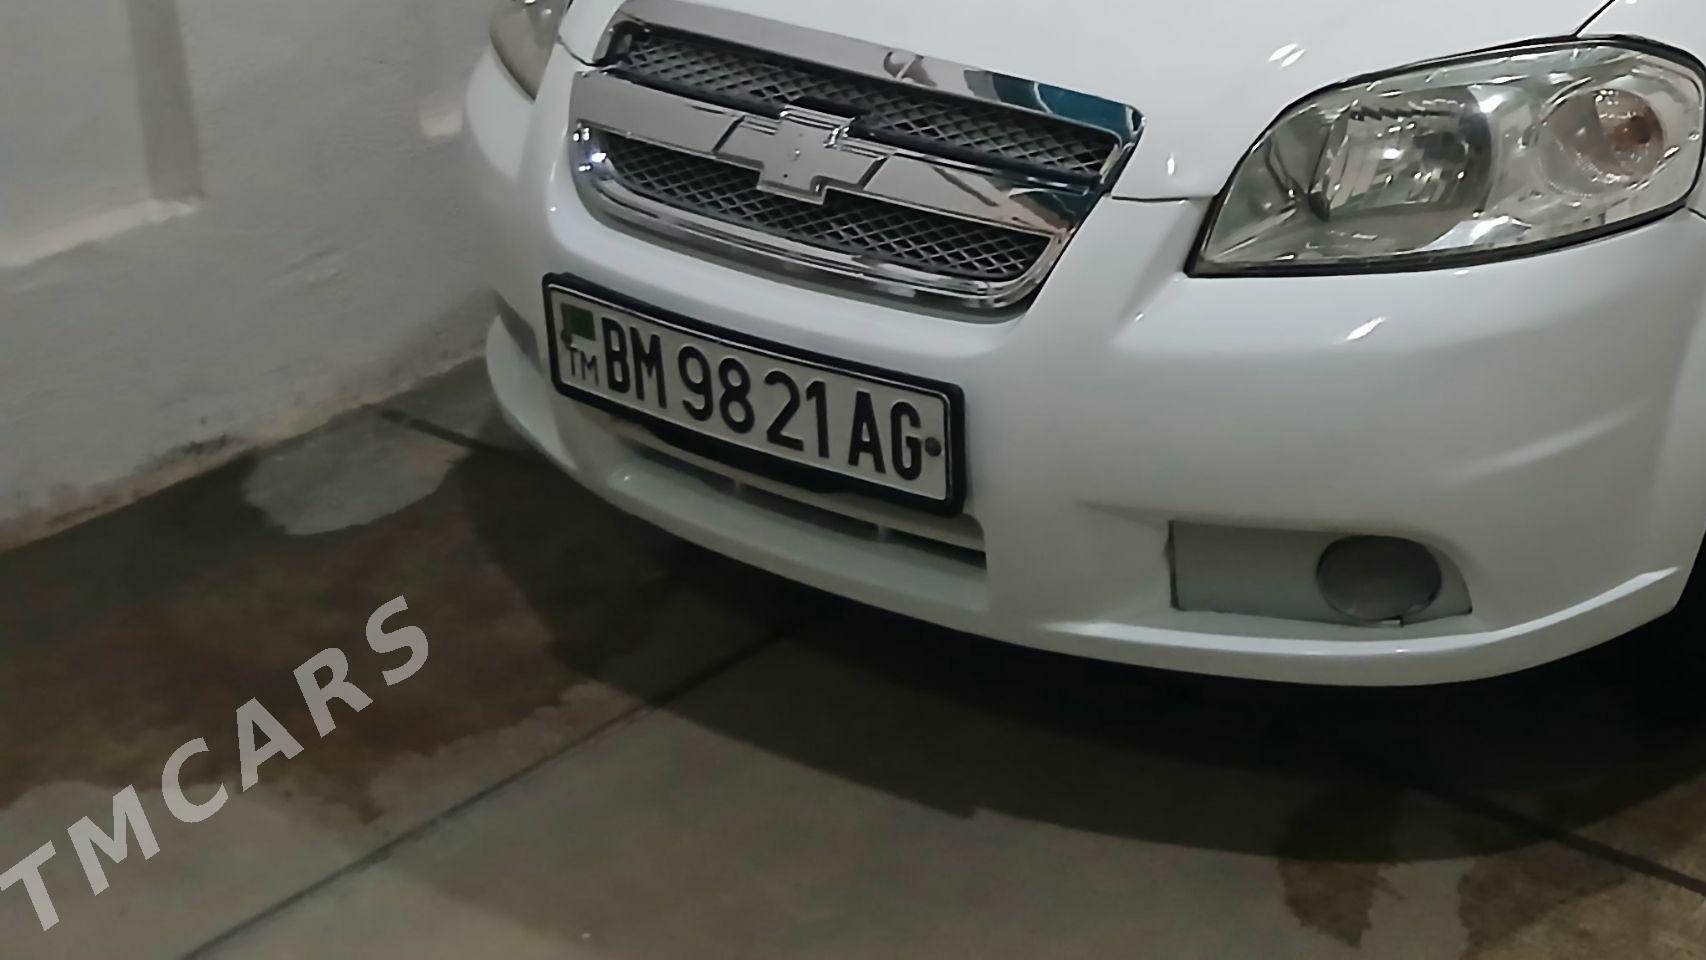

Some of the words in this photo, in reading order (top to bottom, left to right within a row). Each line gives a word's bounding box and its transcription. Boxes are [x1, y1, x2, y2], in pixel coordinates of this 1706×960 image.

[566, 344, 599, 387] TM
[601, 316, 667, 409] BM
[678, 345, 830, 459] 9821
[848, 390, 922, 481] AG
